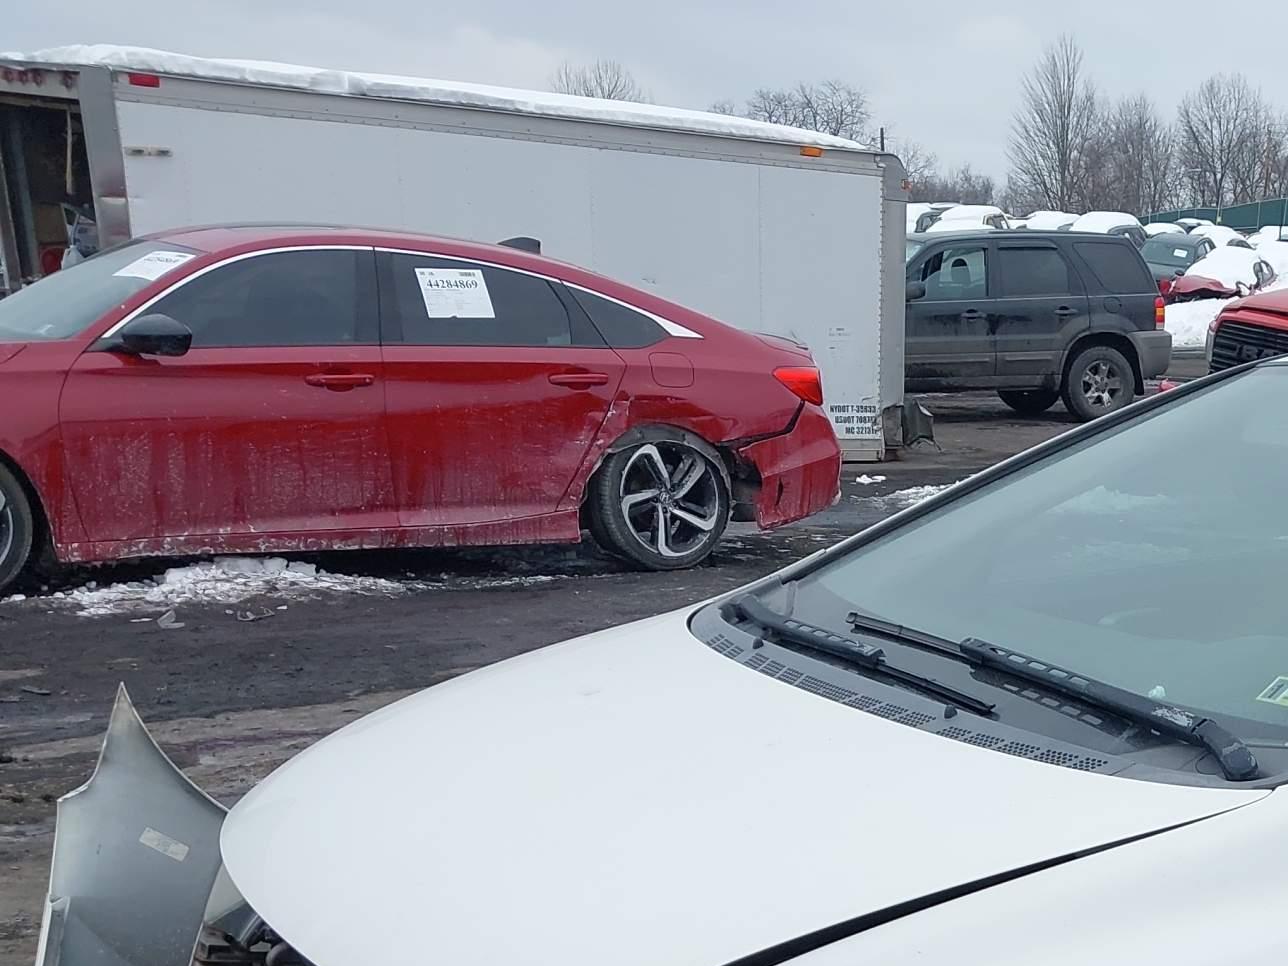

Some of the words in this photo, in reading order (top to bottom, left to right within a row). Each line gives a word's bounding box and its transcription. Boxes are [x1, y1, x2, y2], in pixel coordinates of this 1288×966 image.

[427, 279, 478, 289] 44284869
[830, 405, 849, 413] NYDOT
[845, 427, 855, 435] MC
